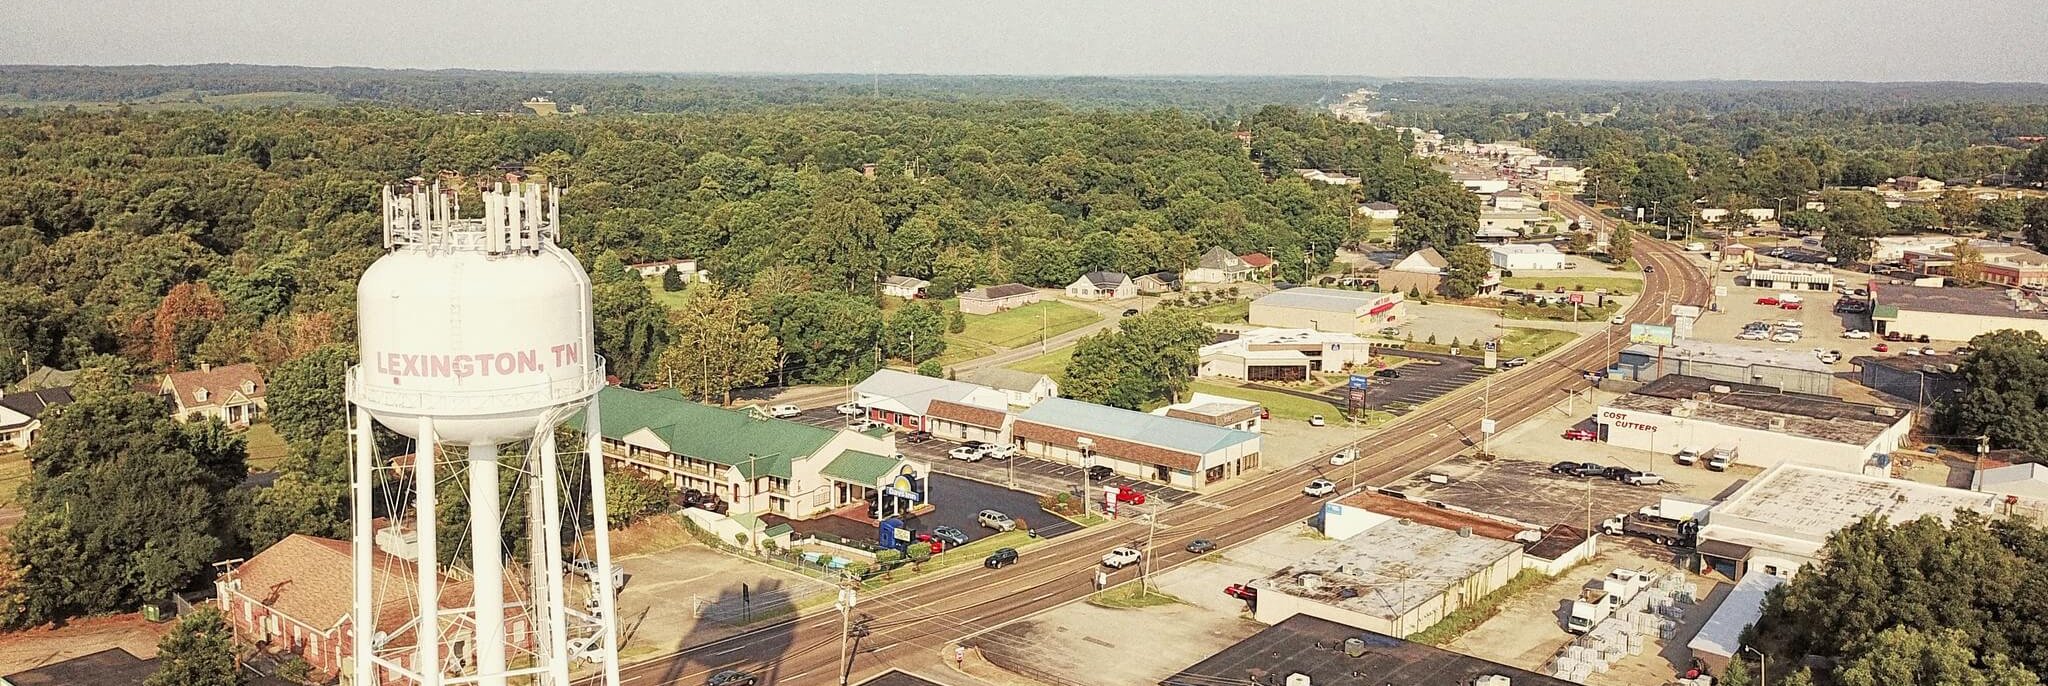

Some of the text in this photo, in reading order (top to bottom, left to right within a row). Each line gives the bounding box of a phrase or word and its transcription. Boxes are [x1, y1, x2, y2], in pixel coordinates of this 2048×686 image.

[377, 342, 578, 378] LEXINGTON, TN
[1604, 412, 1627, 420] COST
[1615, 421, 1657, 432] CUTTERS
